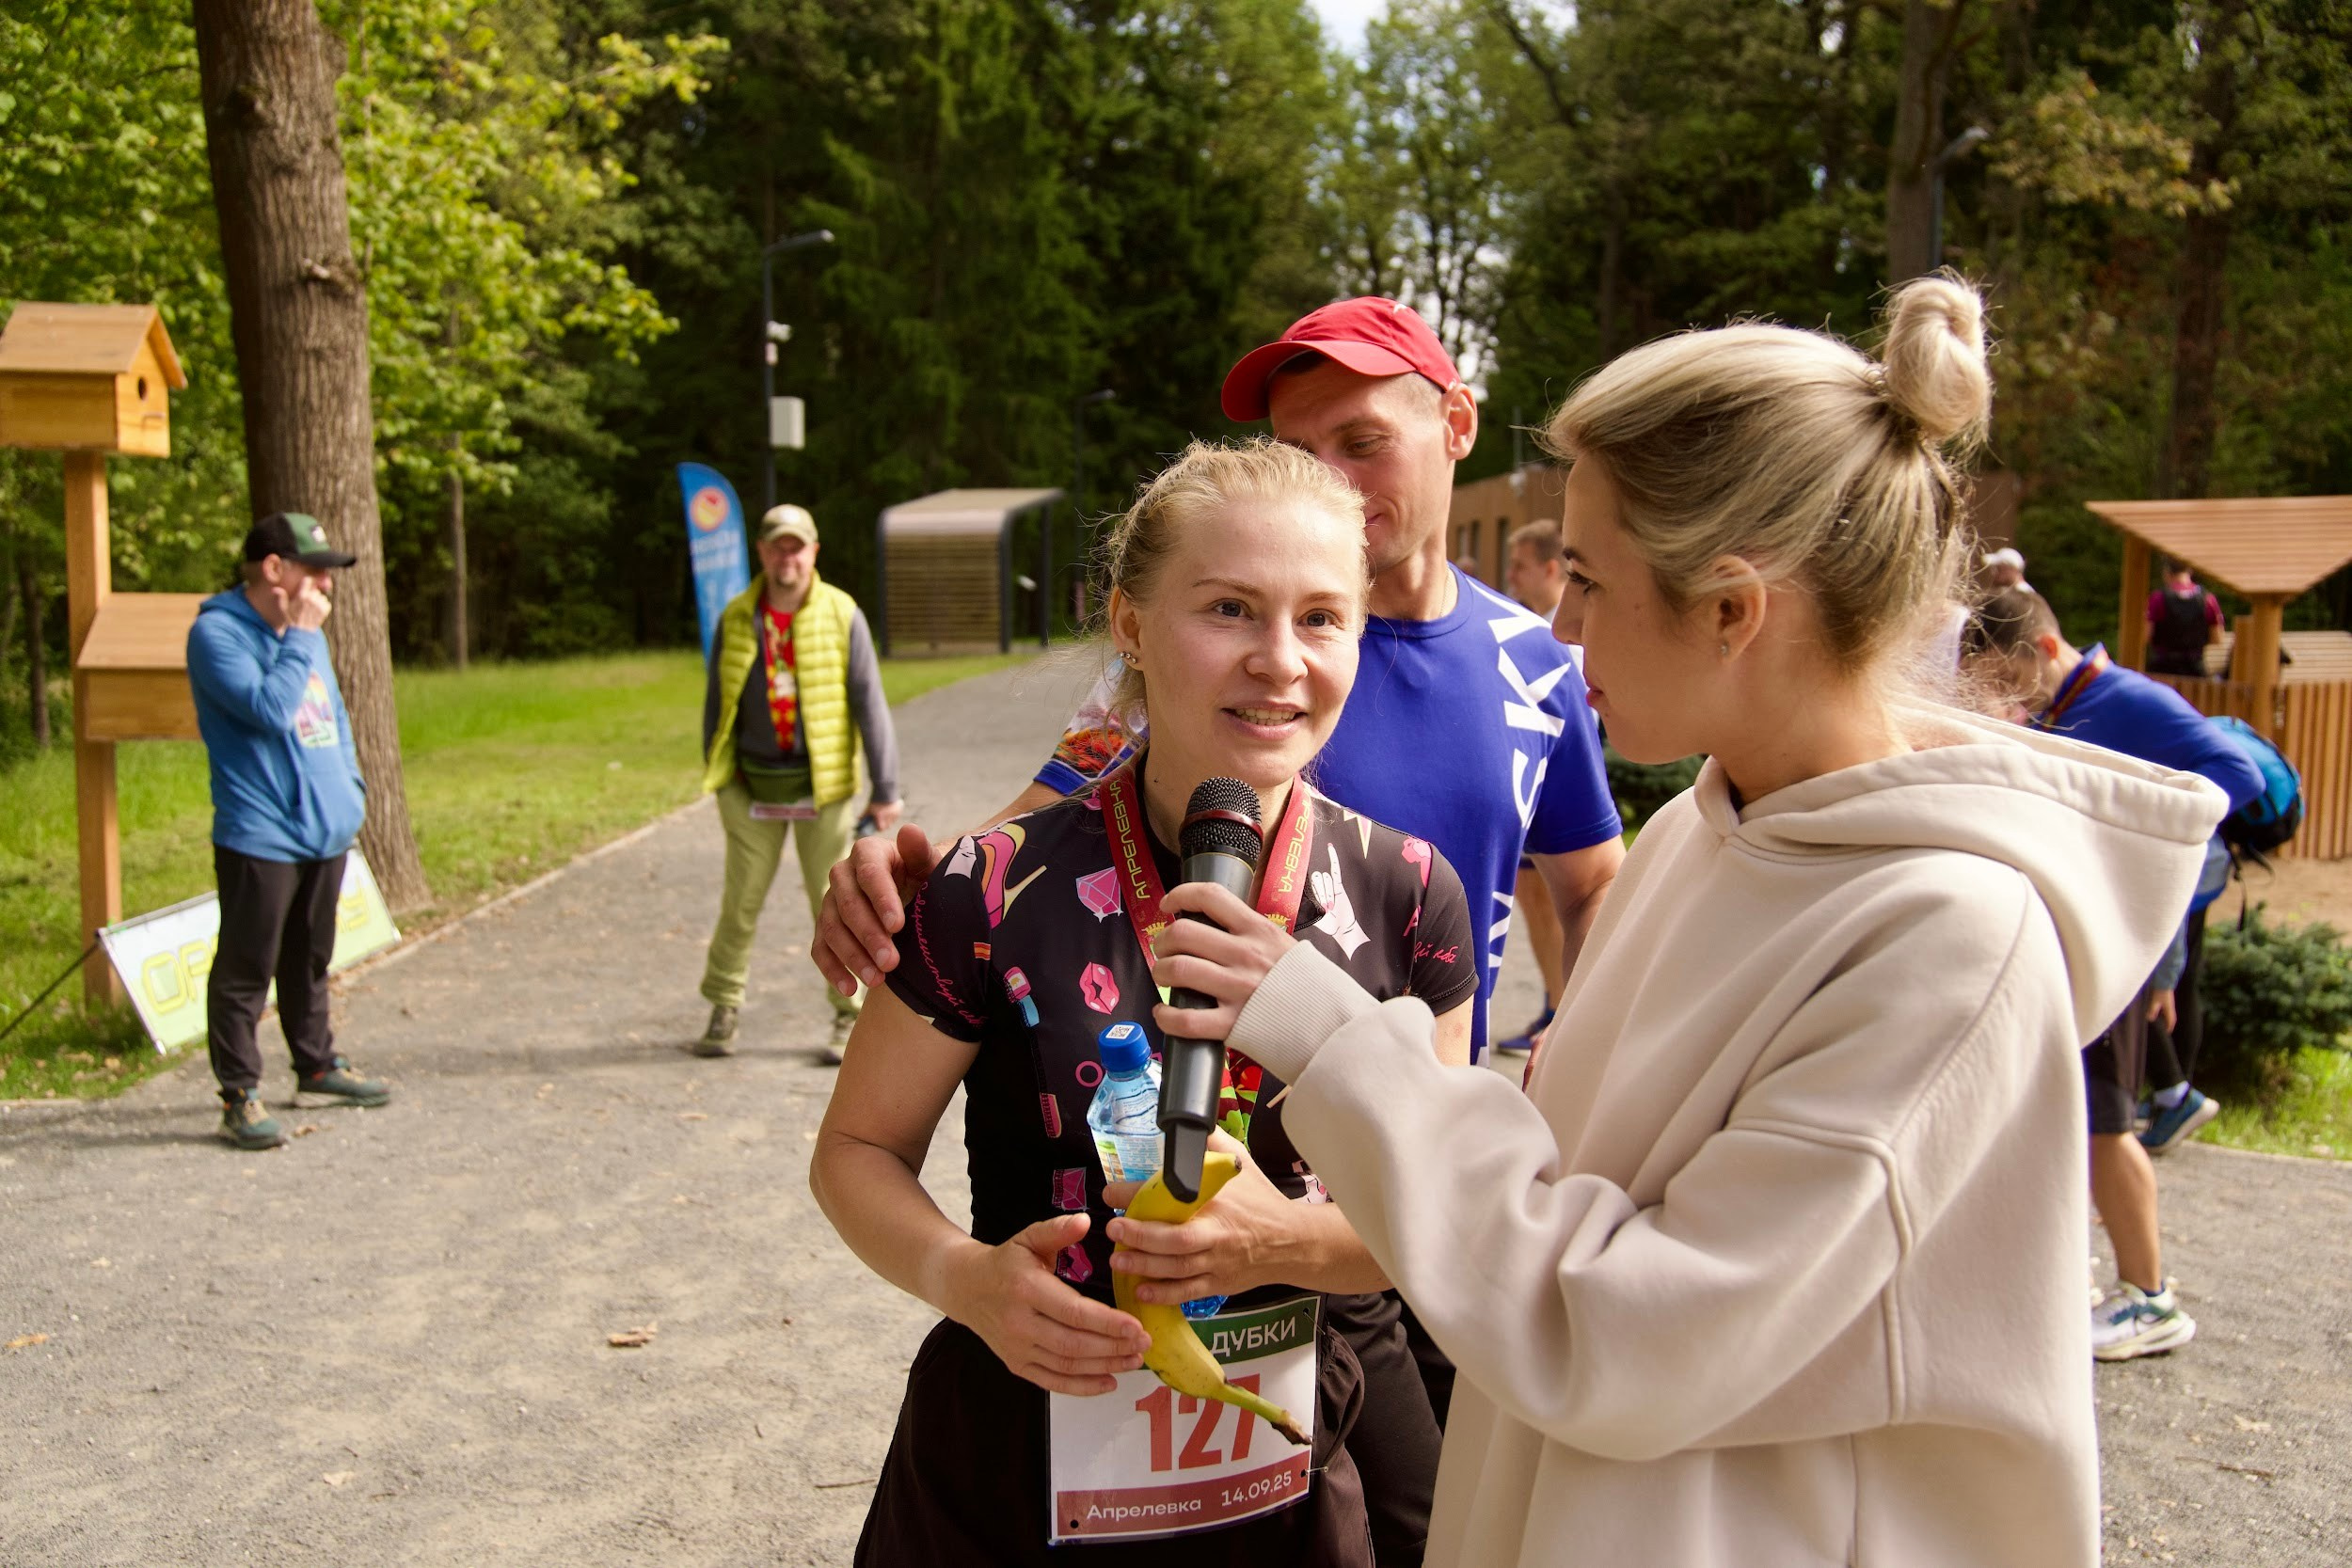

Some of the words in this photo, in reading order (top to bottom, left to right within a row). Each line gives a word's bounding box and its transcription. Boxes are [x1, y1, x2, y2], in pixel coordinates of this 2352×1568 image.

[1109, 779, 1151, 900] АПРЕЛЕВКА
[1211, 1315, 1296, 1356] ДУБКИ
[1135, 1372, 1262, 1473] 127
[1086, 1497, 1201, 1522] Апрелевка
[1220, 1469, 1293, 1507] 14.09.25
